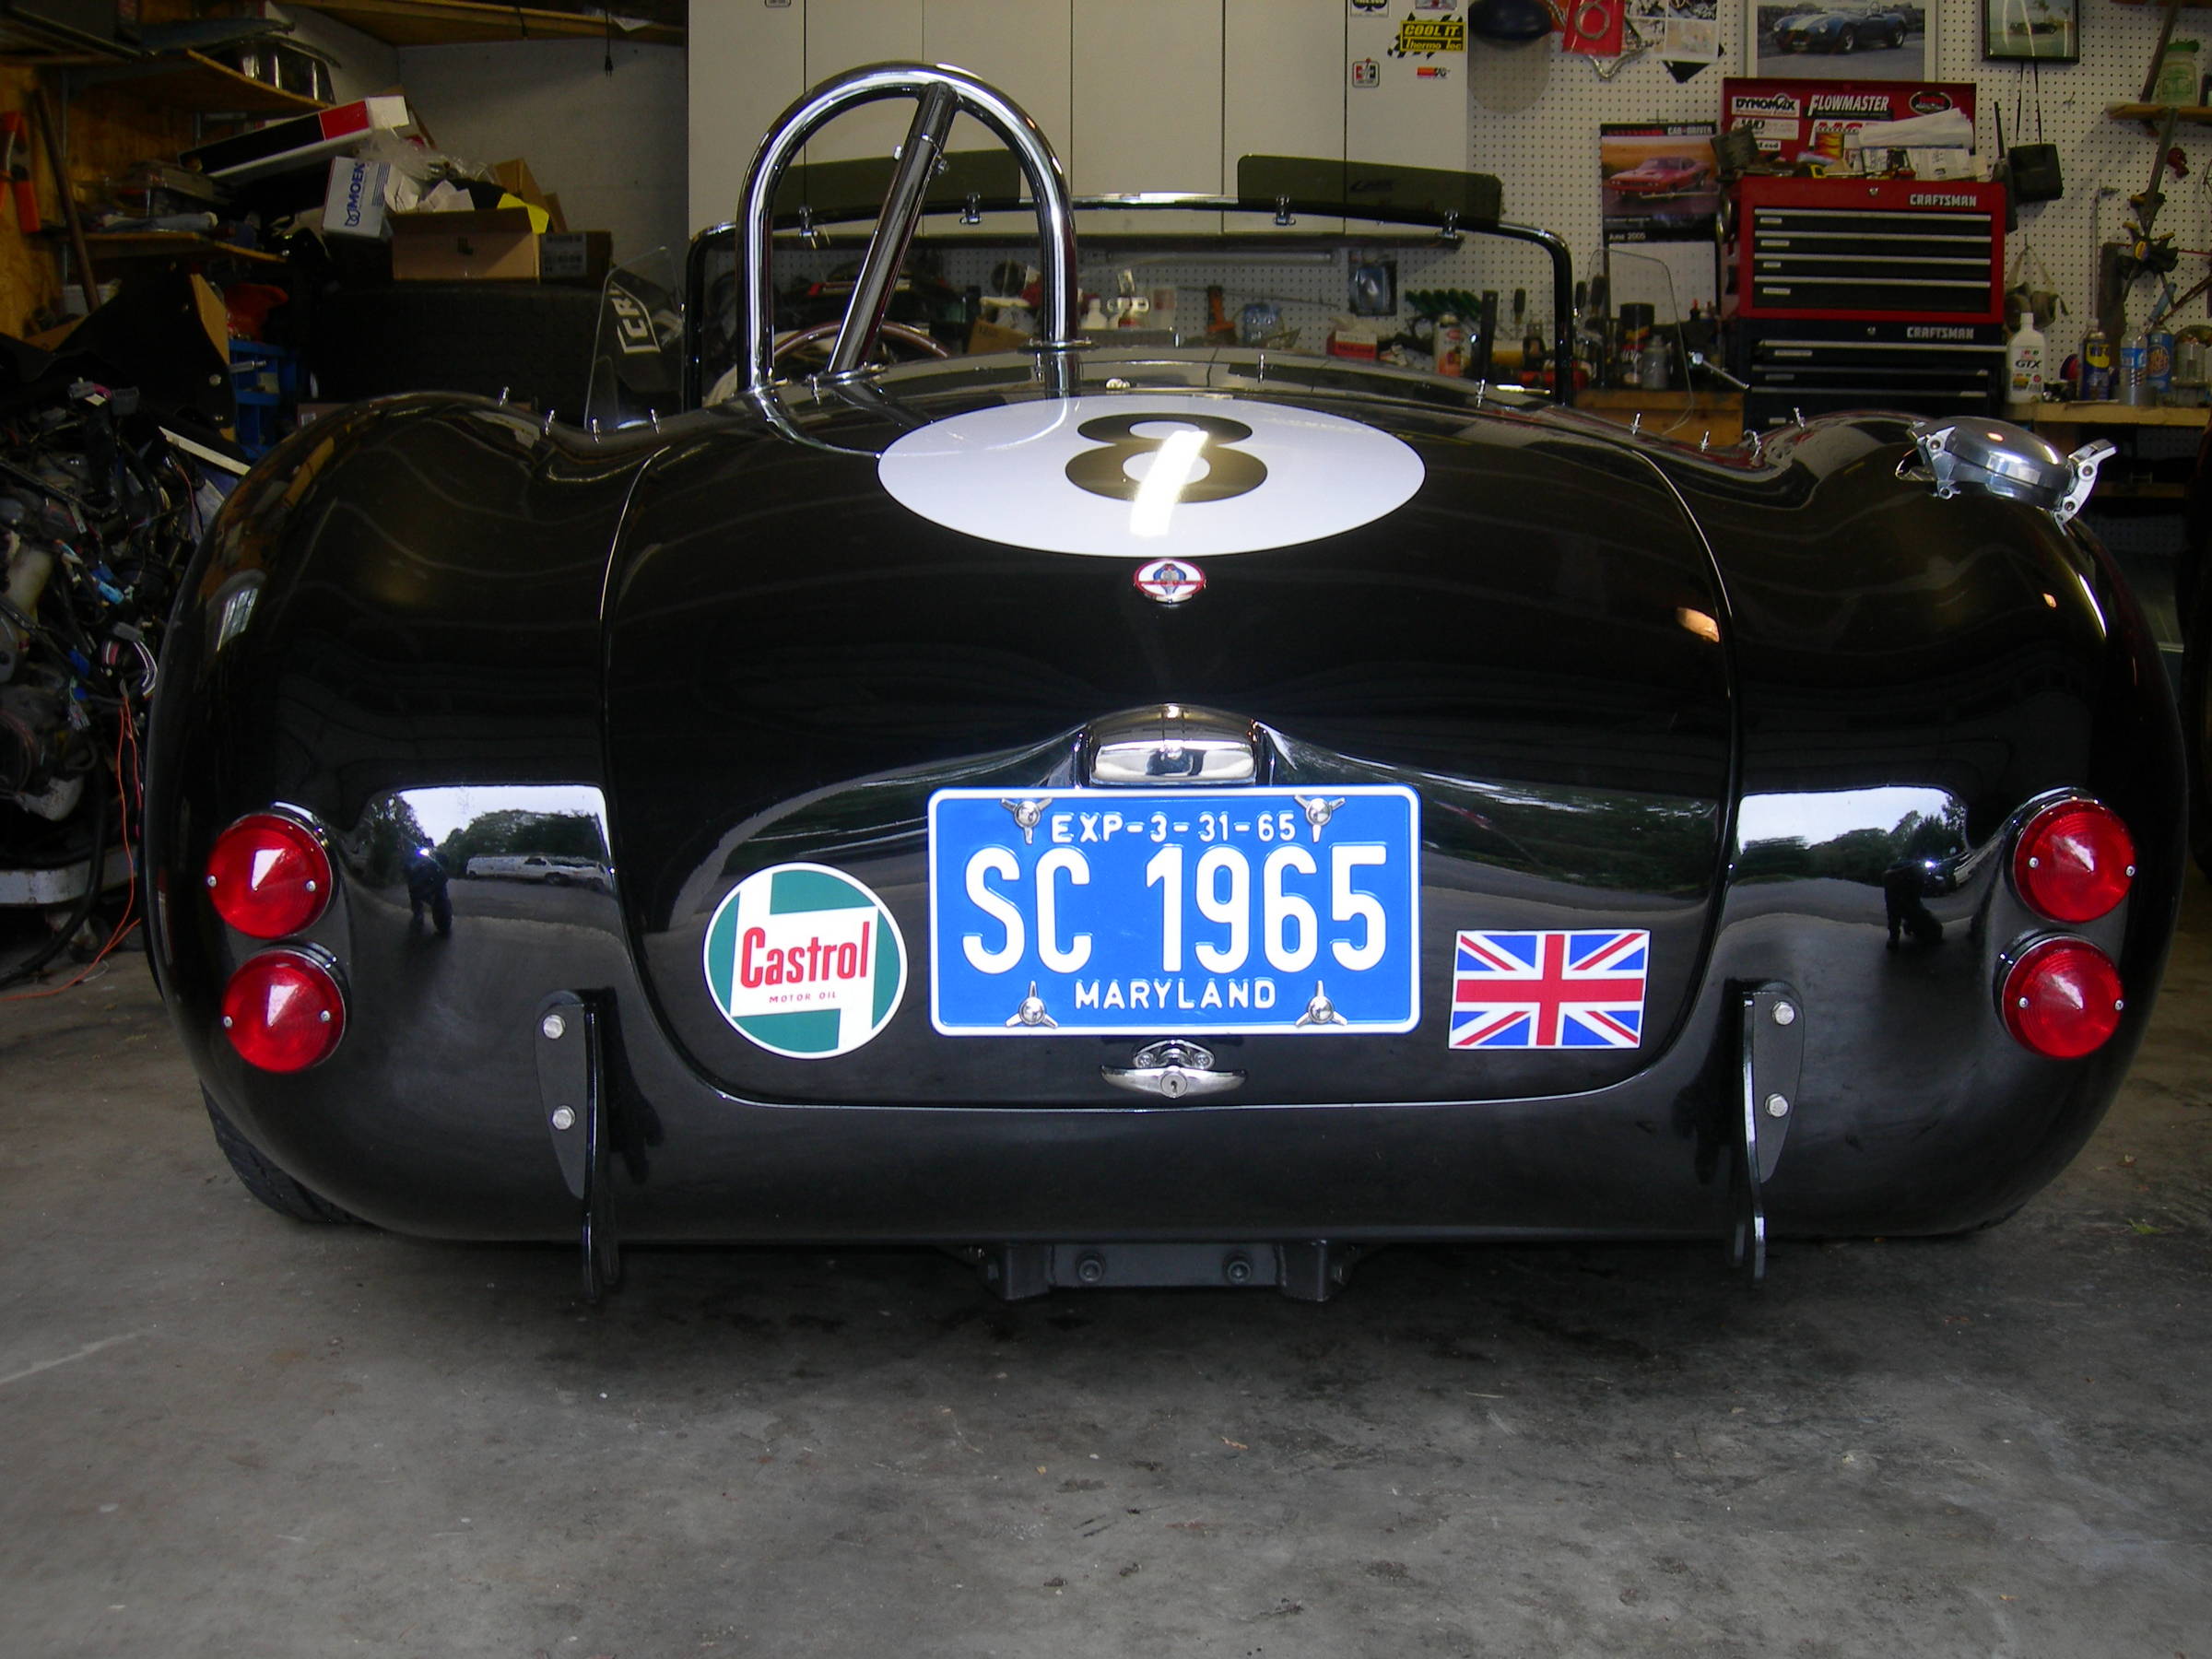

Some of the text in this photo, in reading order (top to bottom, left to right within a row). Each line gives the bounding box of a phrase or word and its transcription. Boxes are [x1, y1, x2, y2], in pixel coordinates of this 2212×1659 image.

[1405, 25, 1459, 36] COOL IT
[1406, 38, 1441, 50] Thermo
[1735, 98, 1795, 111] DYNOMAX
[1807, 95, 1889, 117] FLOWMASTER
[1910, 194, 1977, 207] CRAFTSMAN
[1907, 327, 1974, 340] CRAFTSMAN
[2016, 359, 2041, 370] GTX
[1065, 413, 1267, 503] 8
[961, 843, 1387, 974] SC 1965
[740, 921, 870, 989] Castrol
[769, 991, 837, 1004] MOTOR OIL
[1075, 979, 1277, 1010] MARYLAND
